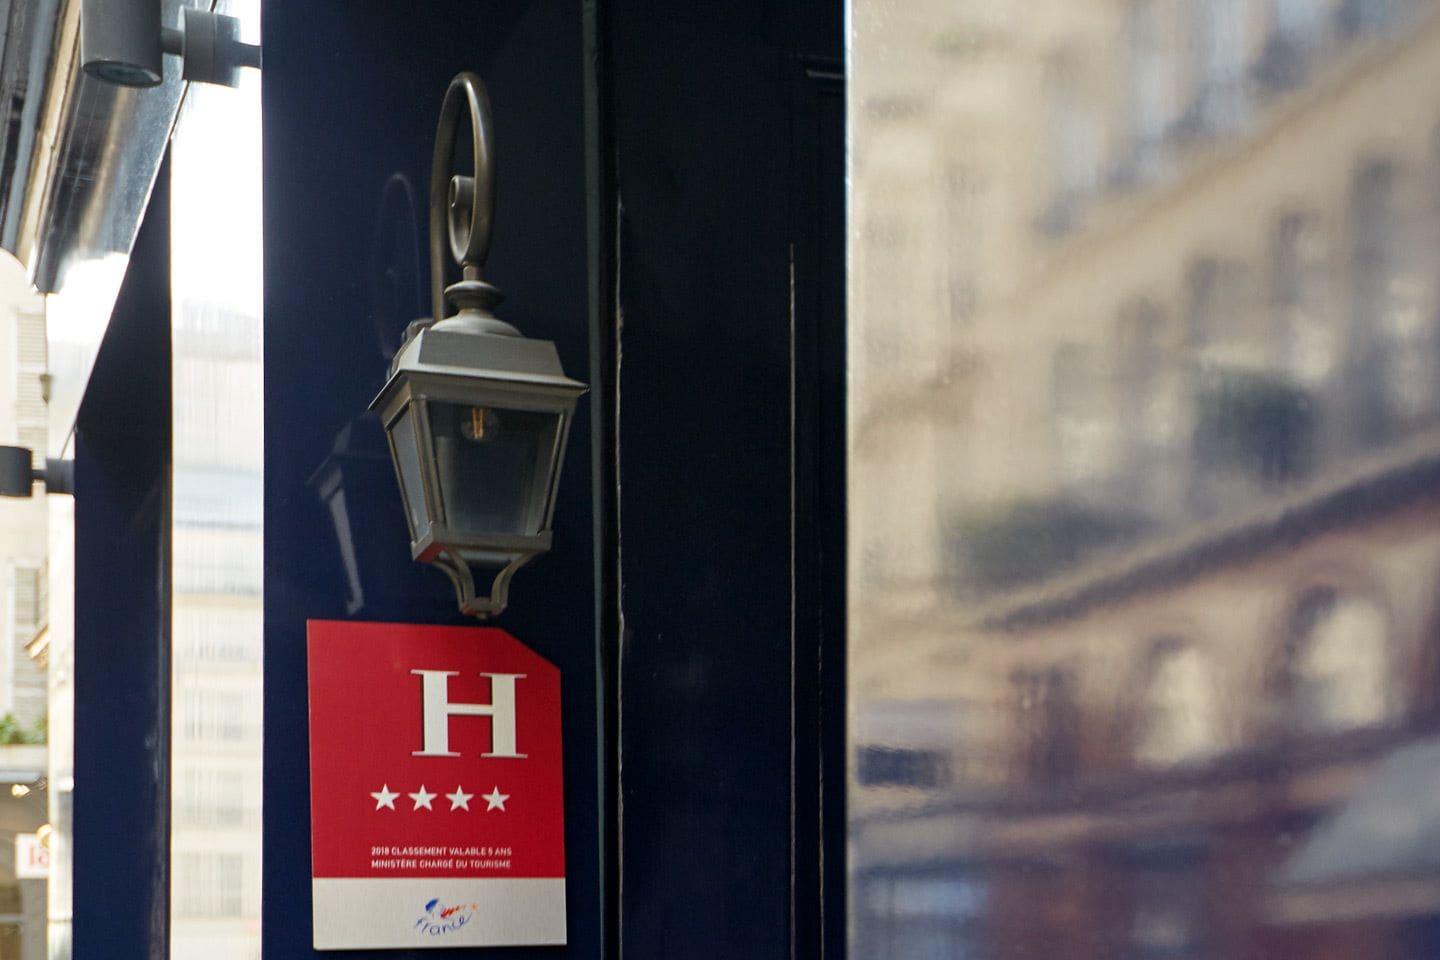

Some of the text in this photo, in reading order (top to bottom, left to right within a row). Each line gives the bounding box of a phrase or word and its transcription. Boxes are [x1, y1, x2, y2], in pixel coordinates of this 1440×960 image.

[410, 669, 528, 759] H
[371, 846, 389, 856] 2018
[391, 846, 447, 856] CLASSEMENT
[449, 846, 486, 856] VALABLE
[495, 846, 512, 856] ANS
[371, 858, 511, 869] MINISTÈRE CHARGÉ DU TOURISME
